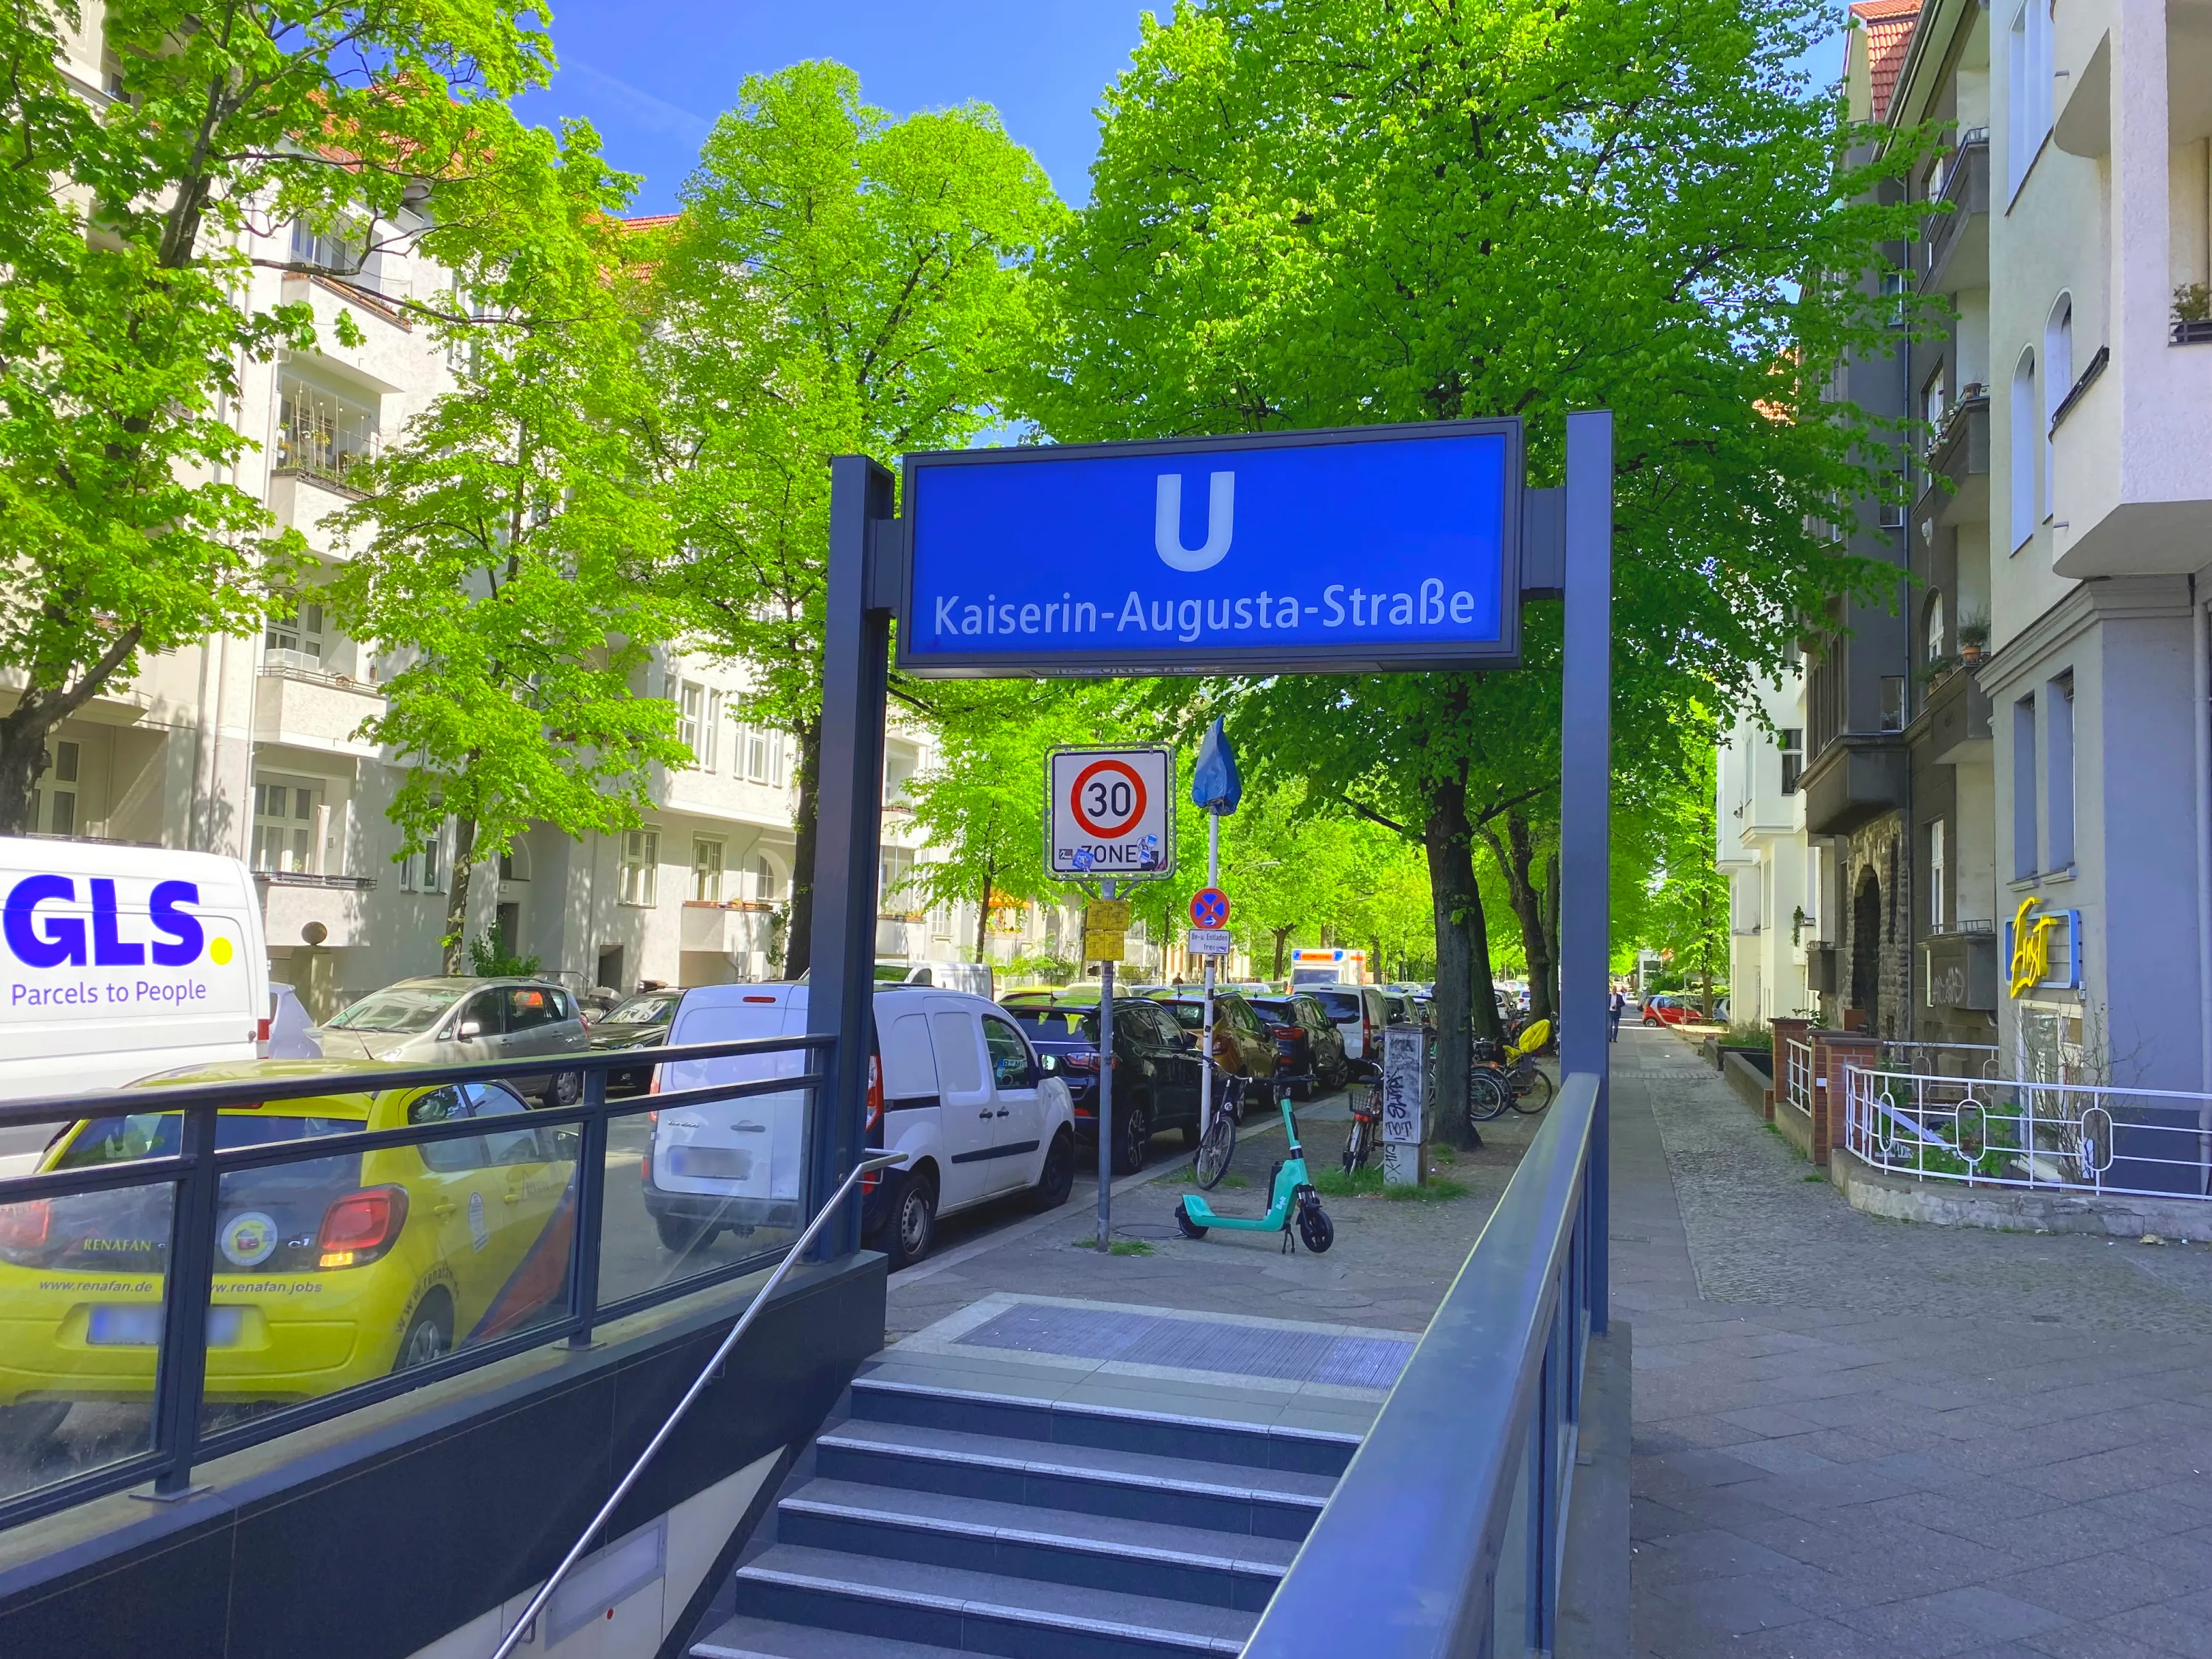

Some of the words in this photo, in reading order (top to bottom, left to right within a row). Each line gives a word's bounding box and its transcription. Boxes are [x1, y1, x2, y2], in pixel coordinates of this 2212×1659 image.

[1155, 470, 1236, 573] U
[934, 577, 1475, 643] Kaiserin-Augusta-Straße
[1087, 782, 1131, 818] 30
[1206, 933, 1228, 942] Entladen
[11, 981, 99, 1006] Parcels
[105, 982, 130, 1003] to
[136, 978, 206, 1006] People
[83, 1238, 152, 1251] RENAFAN
[39, 1280, 153, 1293] www.renafan.de
